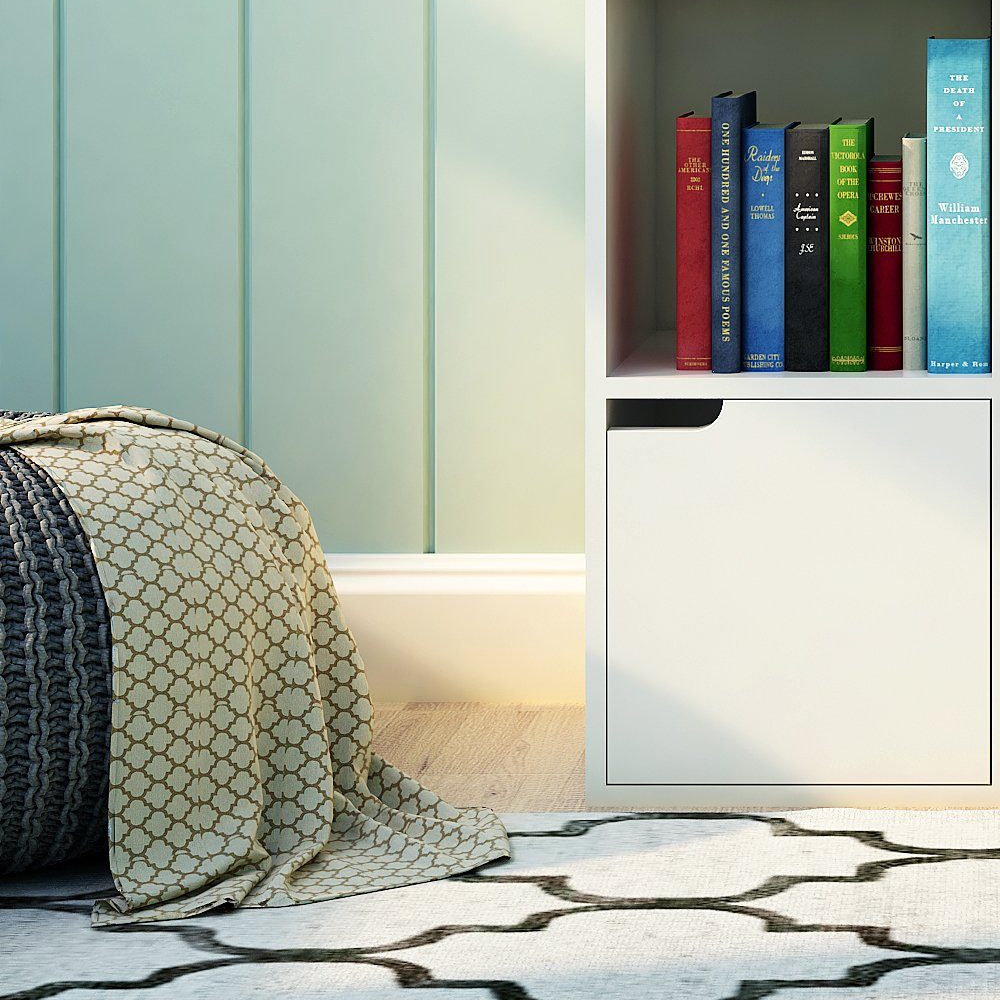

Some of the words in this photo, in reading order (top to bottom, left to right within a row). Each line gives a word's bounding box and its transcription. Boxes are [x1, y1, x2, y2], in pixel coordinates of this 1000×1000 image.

[721, 122, 730, 145] ONE
[839, 165, 857, 173] BOOK
[721, 149, 730, 203] HUNDRED
[837, 178, 847, 186] OF
[847, 178, 859, 186] THE
[837, 191, 859, 199] OPERA
[870, 205, 900, 213] CAREER
[938, 202, 980, 213] William
[721, 207, 730, 230] AND
[930, 214, 988, 225] Manchester
[721, 233, 730, 256] ONE
[721, 259, 730, 302] FAMOUS
[721, 306, 730, 342] POEMS
[746, 353, 766, 361] ARDEN
[767, 353, 781, 361] CITY
[930, 360, 959, 369] Harper
